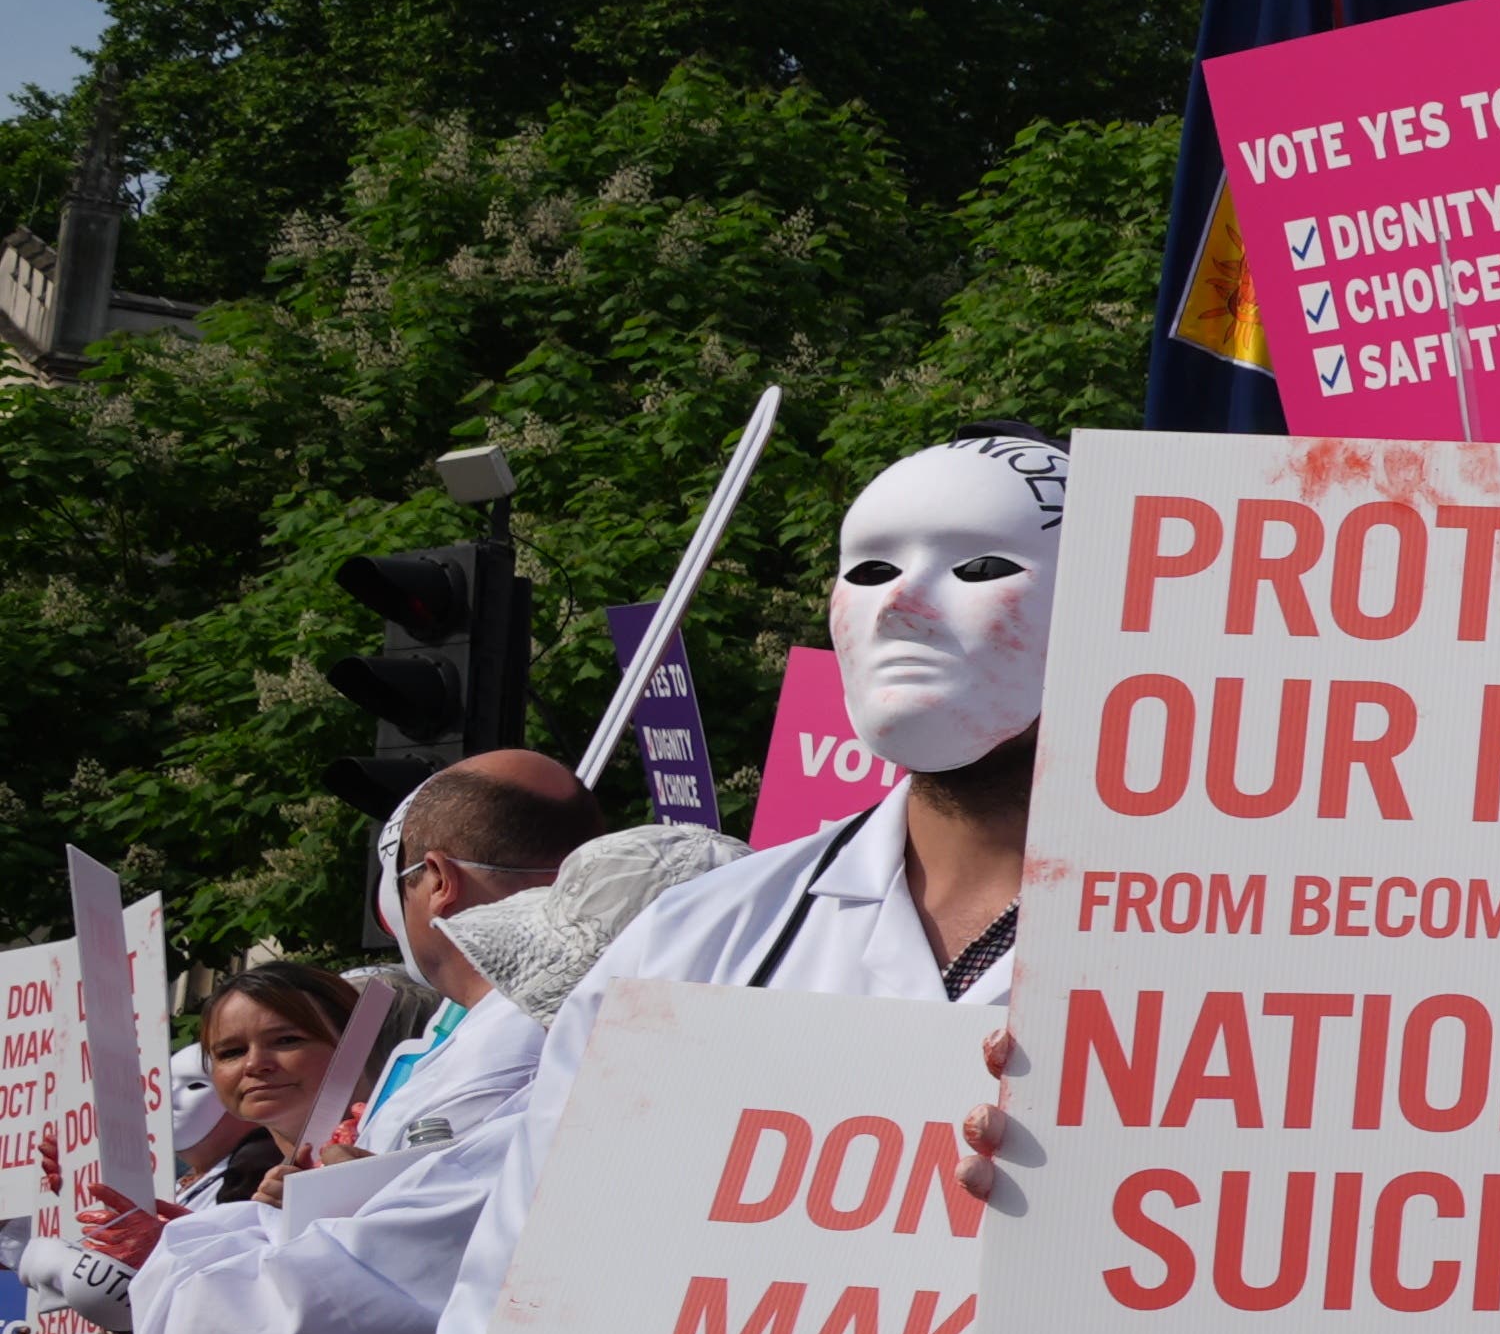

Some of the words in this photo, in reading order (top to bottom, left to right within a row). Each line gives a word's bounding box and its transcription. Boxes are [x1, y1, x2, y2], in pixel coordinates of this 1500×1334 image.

[1239, 122, 1351, 184] VOTE
[1359, 102, 1450, 160] YES
[669, 664, 688, 697] TO
[1095, 673, 1418, 820] OUR
[663, 774, 701, 807] CHOICE
[1079, 871, 1267, 935] FROM
[709, 1109, 983, 1238] DON
